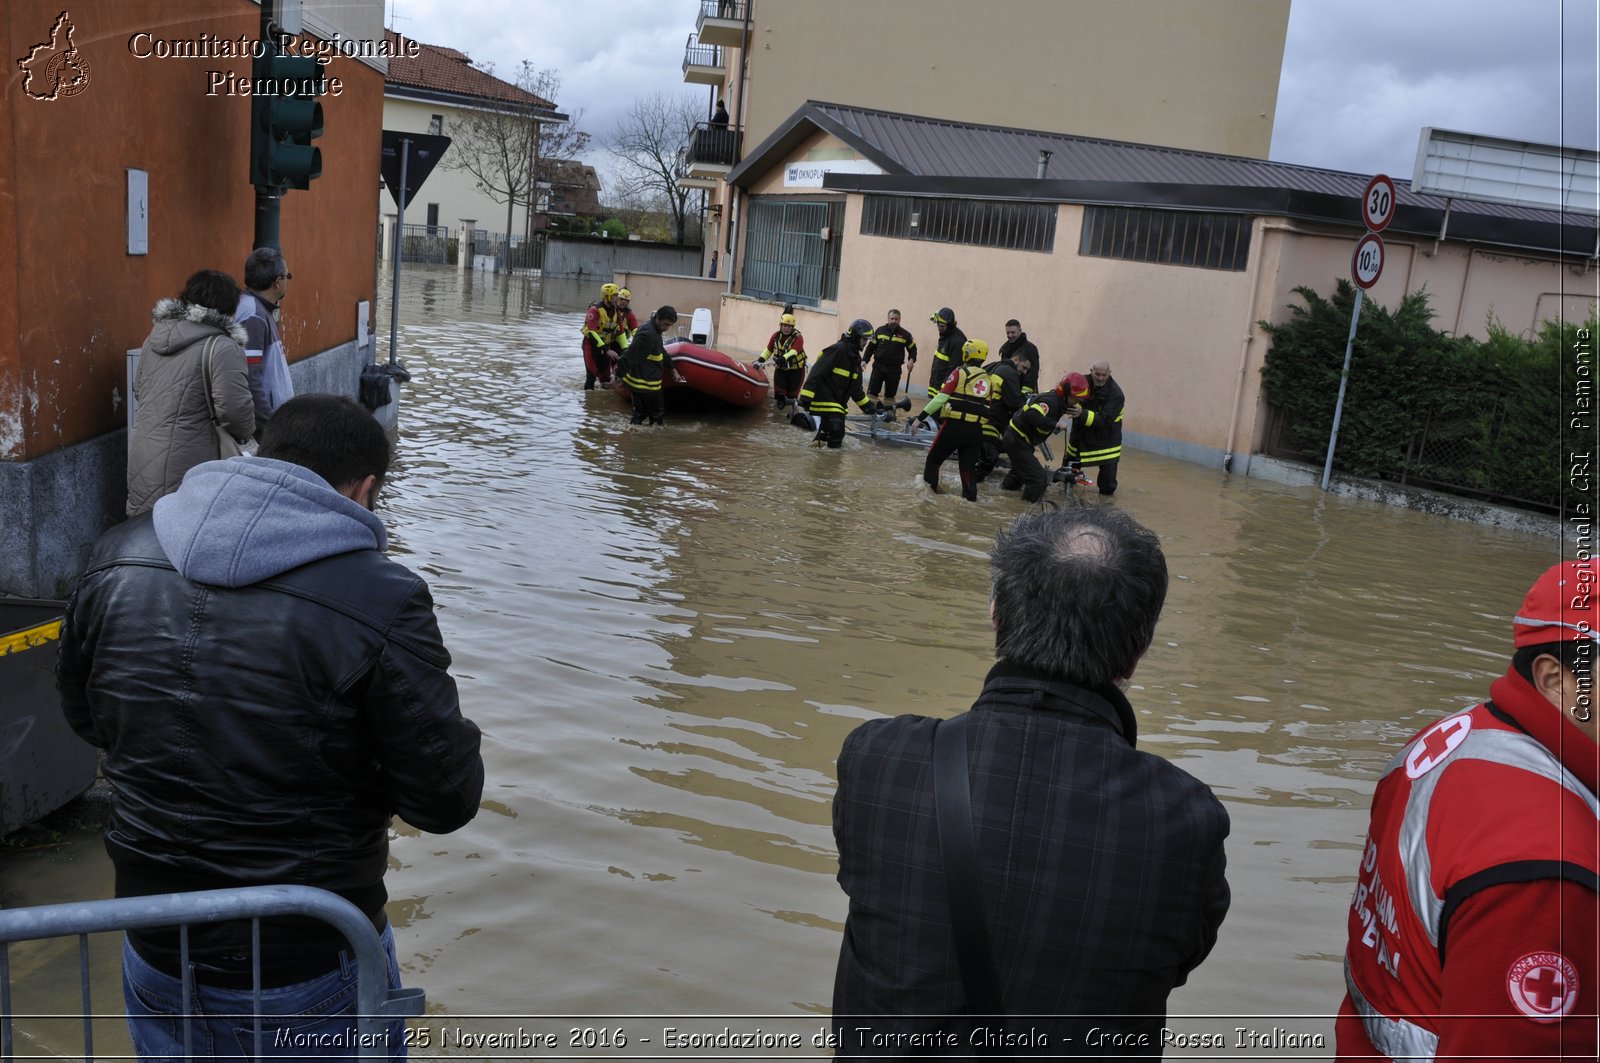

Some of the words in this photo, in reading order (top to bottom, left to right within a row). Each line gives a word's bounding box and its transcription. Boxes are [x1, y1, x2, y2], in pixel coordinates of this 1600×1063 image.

[1370, 189, 1389, 216] 30
[1510, 958, 1532, 983] CROCE
[1530, 954, 1560, 967] ROSSA
